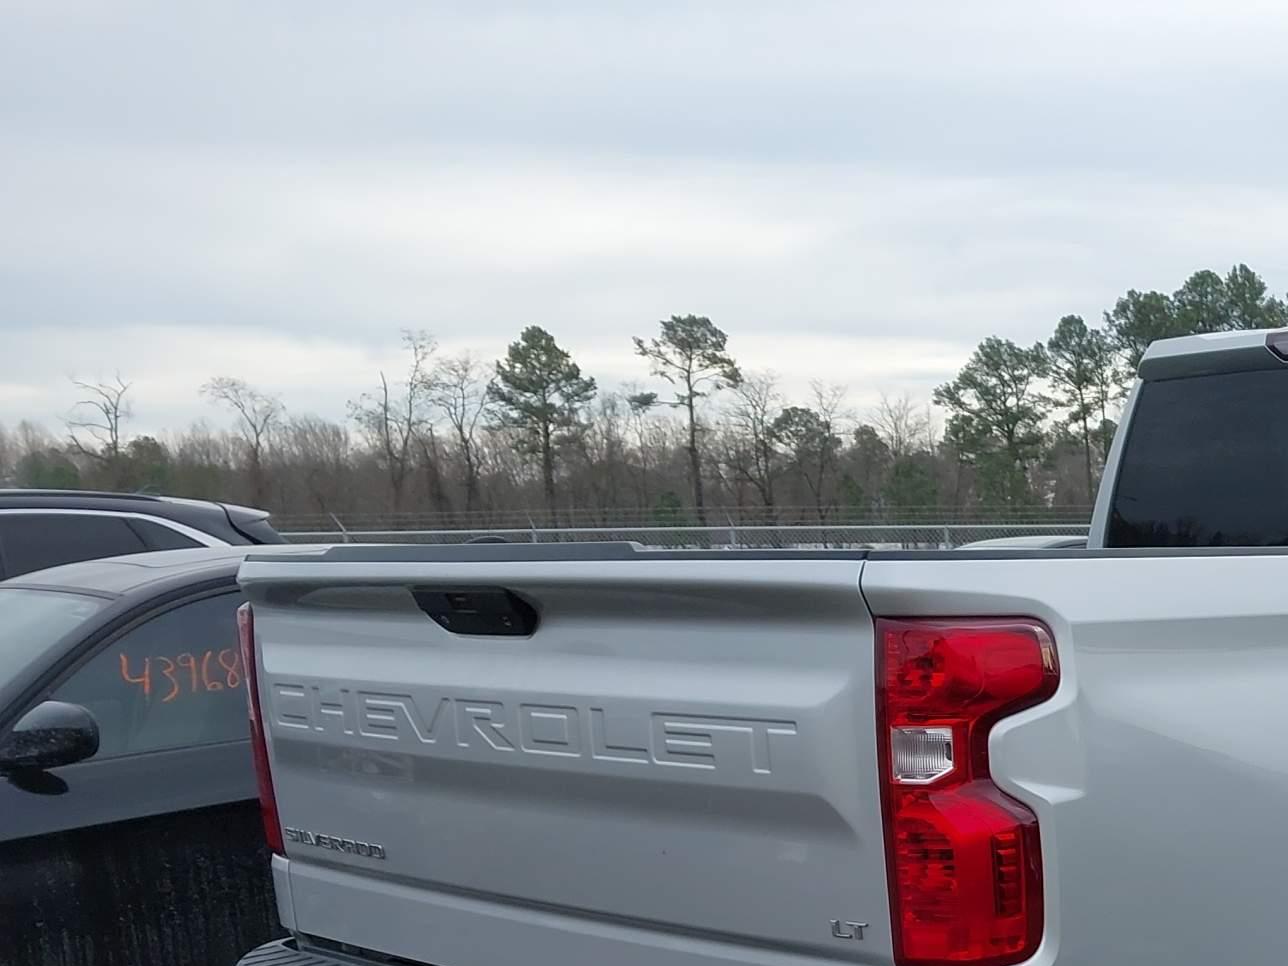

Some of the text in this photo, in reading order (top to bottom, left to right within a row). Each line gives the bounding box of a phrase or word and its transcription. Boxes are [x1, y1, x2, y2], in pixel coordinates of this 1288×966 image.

[273, 682, 798, 775] CHEVROLET
[284, 826, 386, 860] SILVERADO
[830, 918, 869, 940] LT
